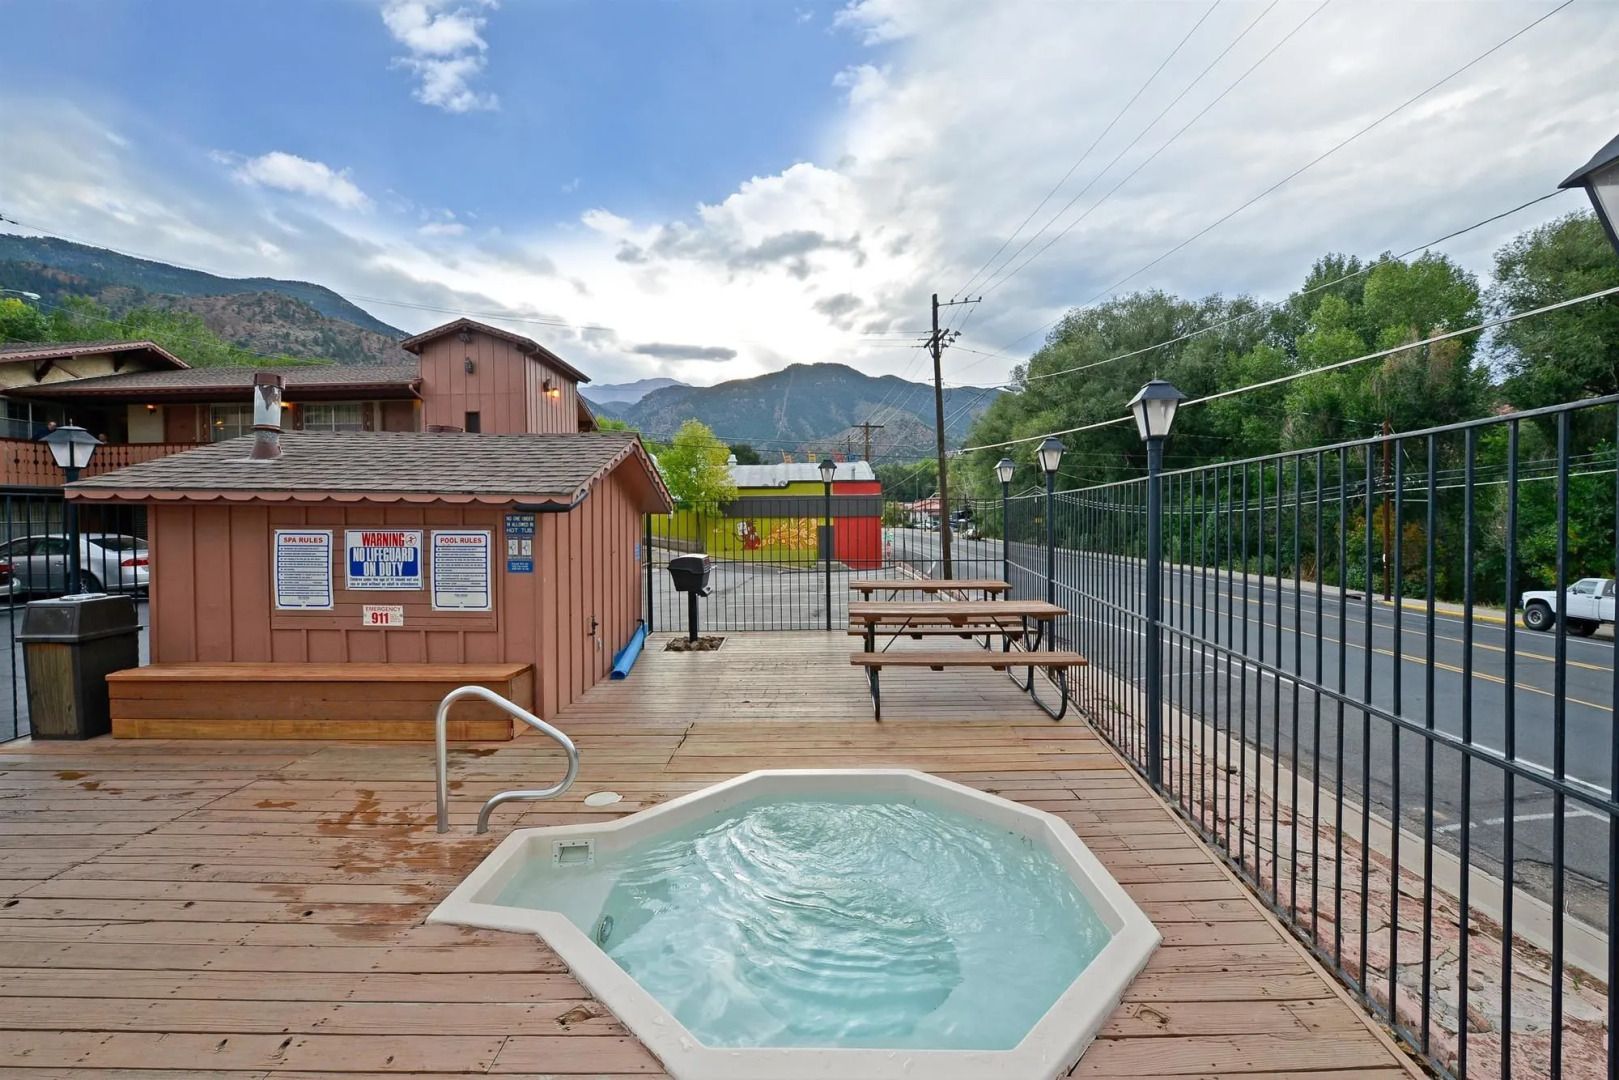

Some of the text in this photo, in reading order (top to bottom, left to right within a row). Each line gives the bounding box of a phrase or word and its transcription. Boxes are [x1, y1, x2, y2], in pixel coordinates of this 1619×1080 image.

[361, 532, 405, 547] WARNING
[353, 547, 414, 562] NO LIFEGUARD
[363, 561, 403, 576] ON DUTY
[371, 612, 389, 624] 911
